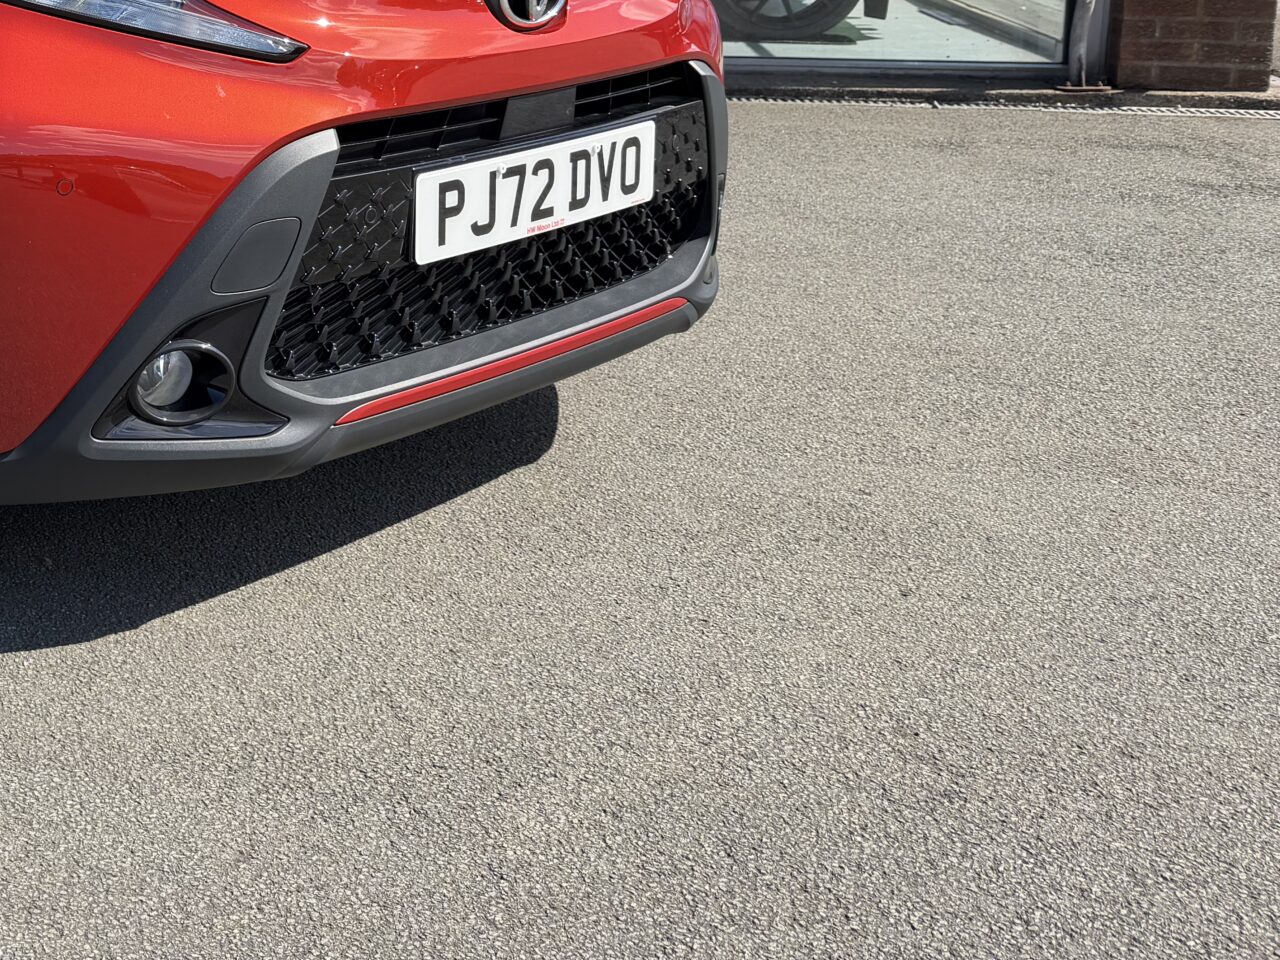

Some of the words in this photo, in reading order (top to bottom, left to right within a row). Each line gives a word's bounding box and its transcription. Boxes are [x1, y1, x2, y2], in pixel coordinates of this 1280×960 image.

[437, 157, 555, 247] PJ72
[568, 135, 641, 212] DVO
[537, 222, 551, 232] Moon
